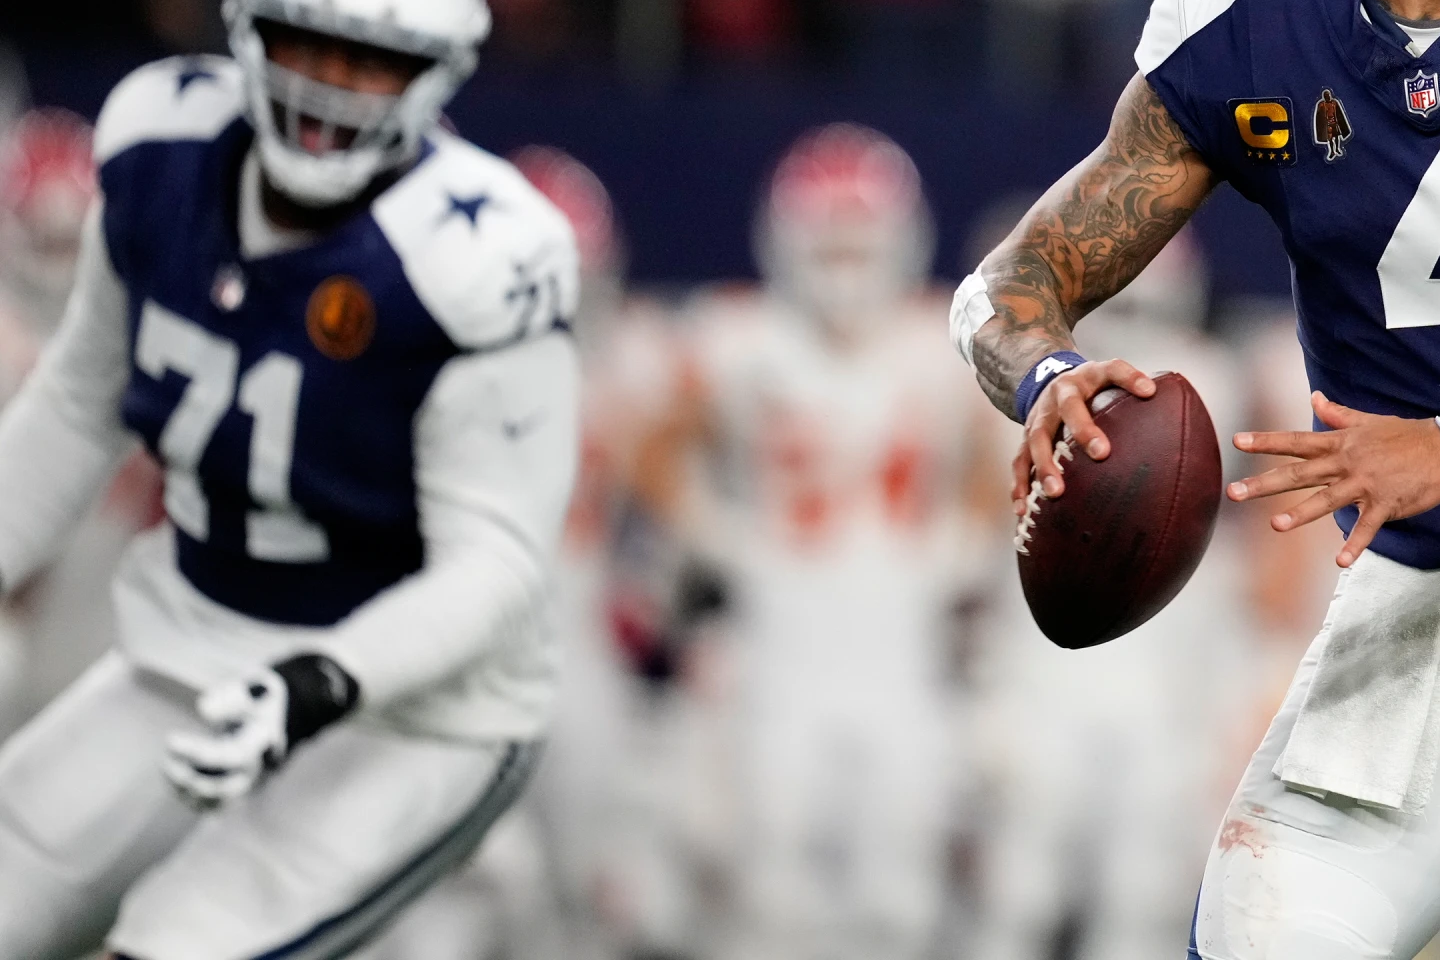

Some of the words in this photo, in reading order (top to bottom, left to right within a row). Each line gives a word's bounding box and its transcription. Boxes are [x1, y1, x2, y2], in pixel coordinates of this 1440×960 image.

[1410, 90, 1435, 109] NFL
[1235, 103, 1289, 149] C
[1036, 356, 1073, 382] 4
[136, 298, 330, 564] 71
